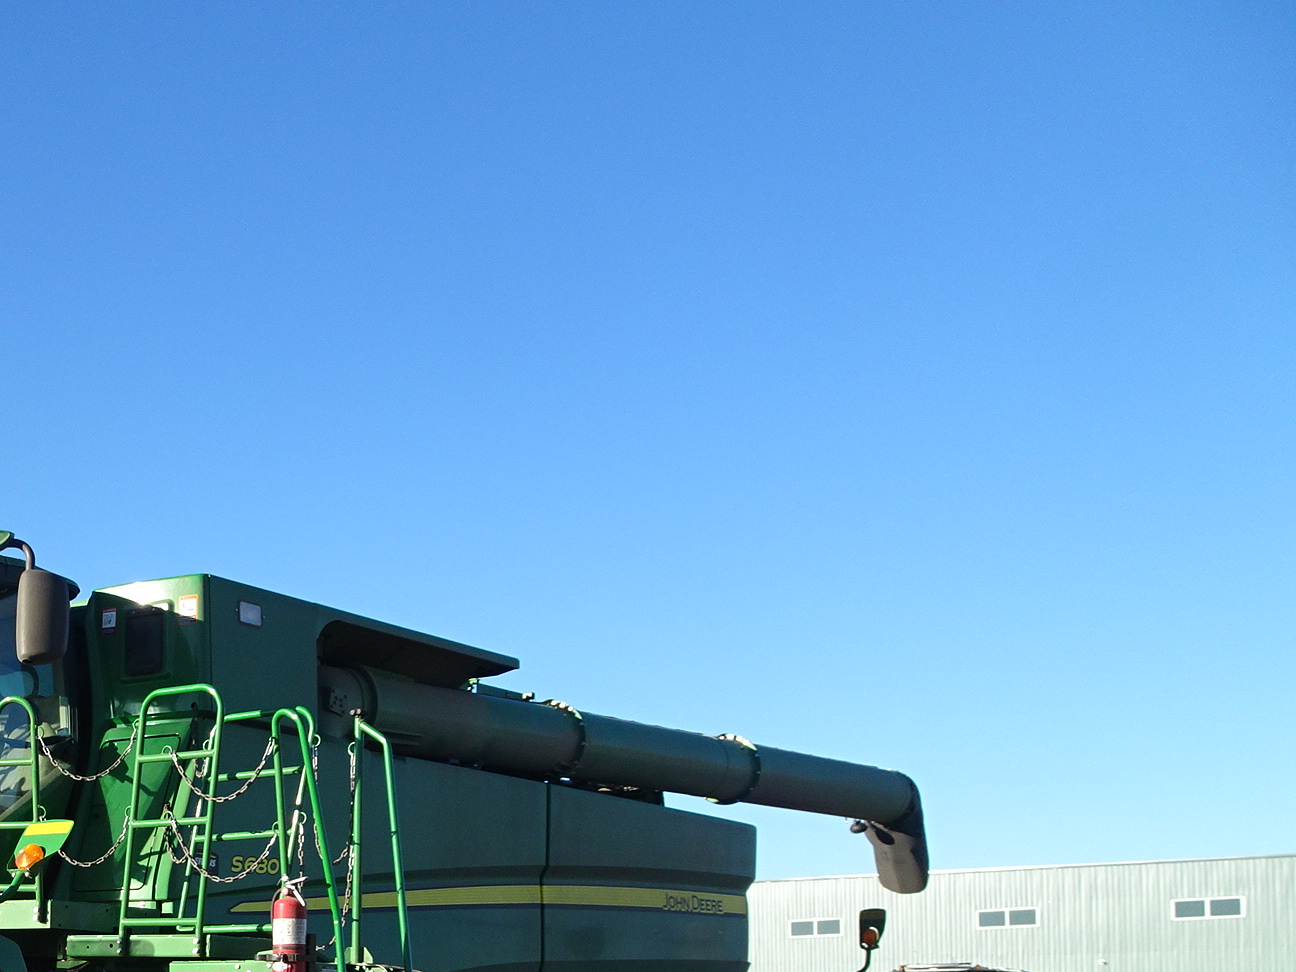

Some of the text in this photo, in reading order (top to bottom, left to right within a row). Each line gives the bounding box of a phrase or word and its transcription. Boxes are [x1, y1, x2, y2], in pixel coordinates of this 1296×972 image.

[230, 855, 281, 875] S680
[662, 892, 724, 913] JOHN DEERE
